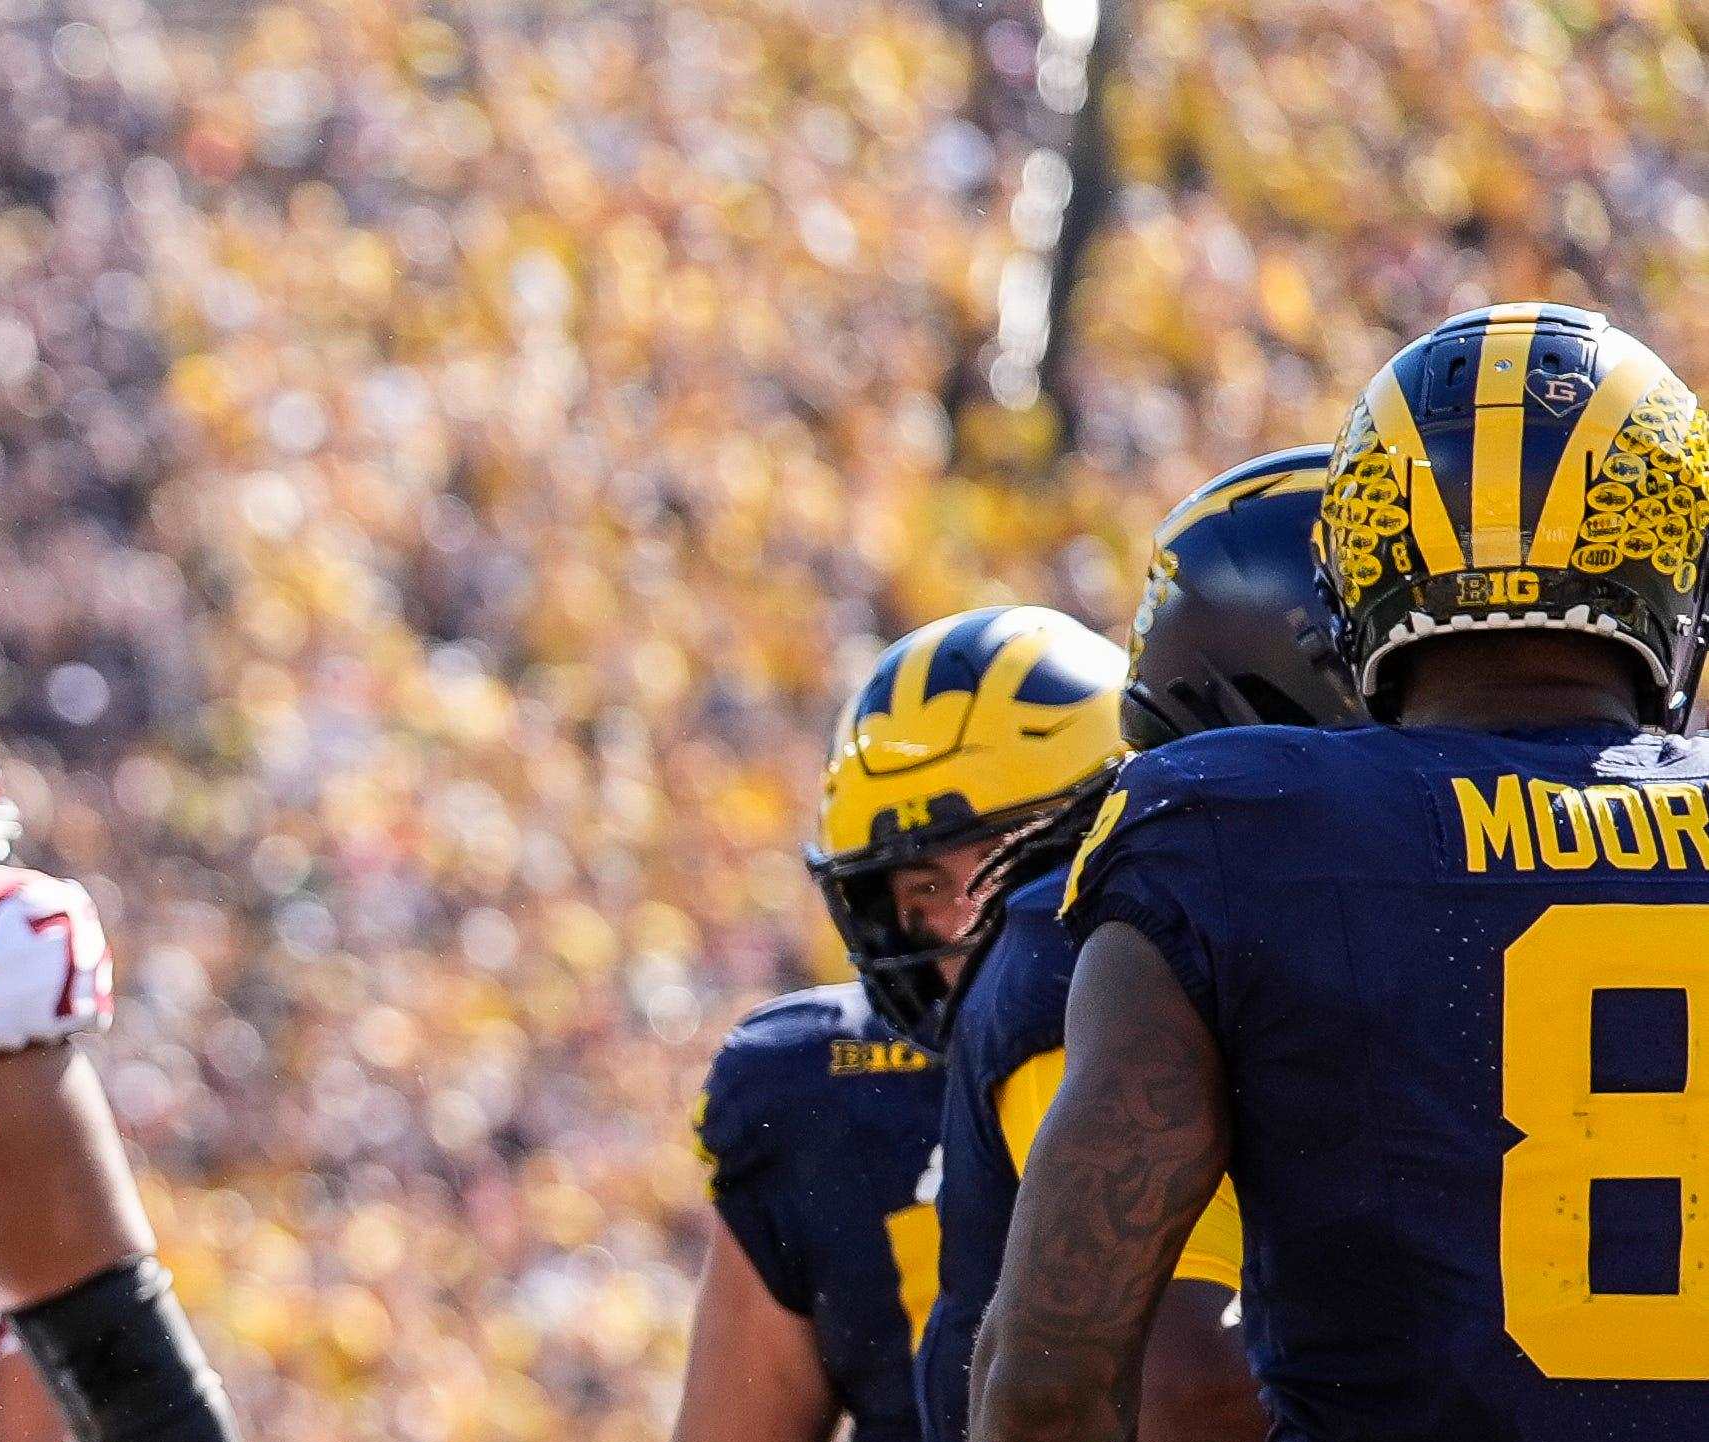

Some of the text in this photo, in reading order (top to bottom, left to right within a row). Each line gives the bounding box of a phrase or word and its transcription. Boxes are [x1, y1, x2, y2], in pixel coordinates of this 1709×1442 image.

[1457, 571, 1540, 606] BIG
[1451, 774, 1709, 872] MOOR
[1500, 904, 1709, 1380] 8
